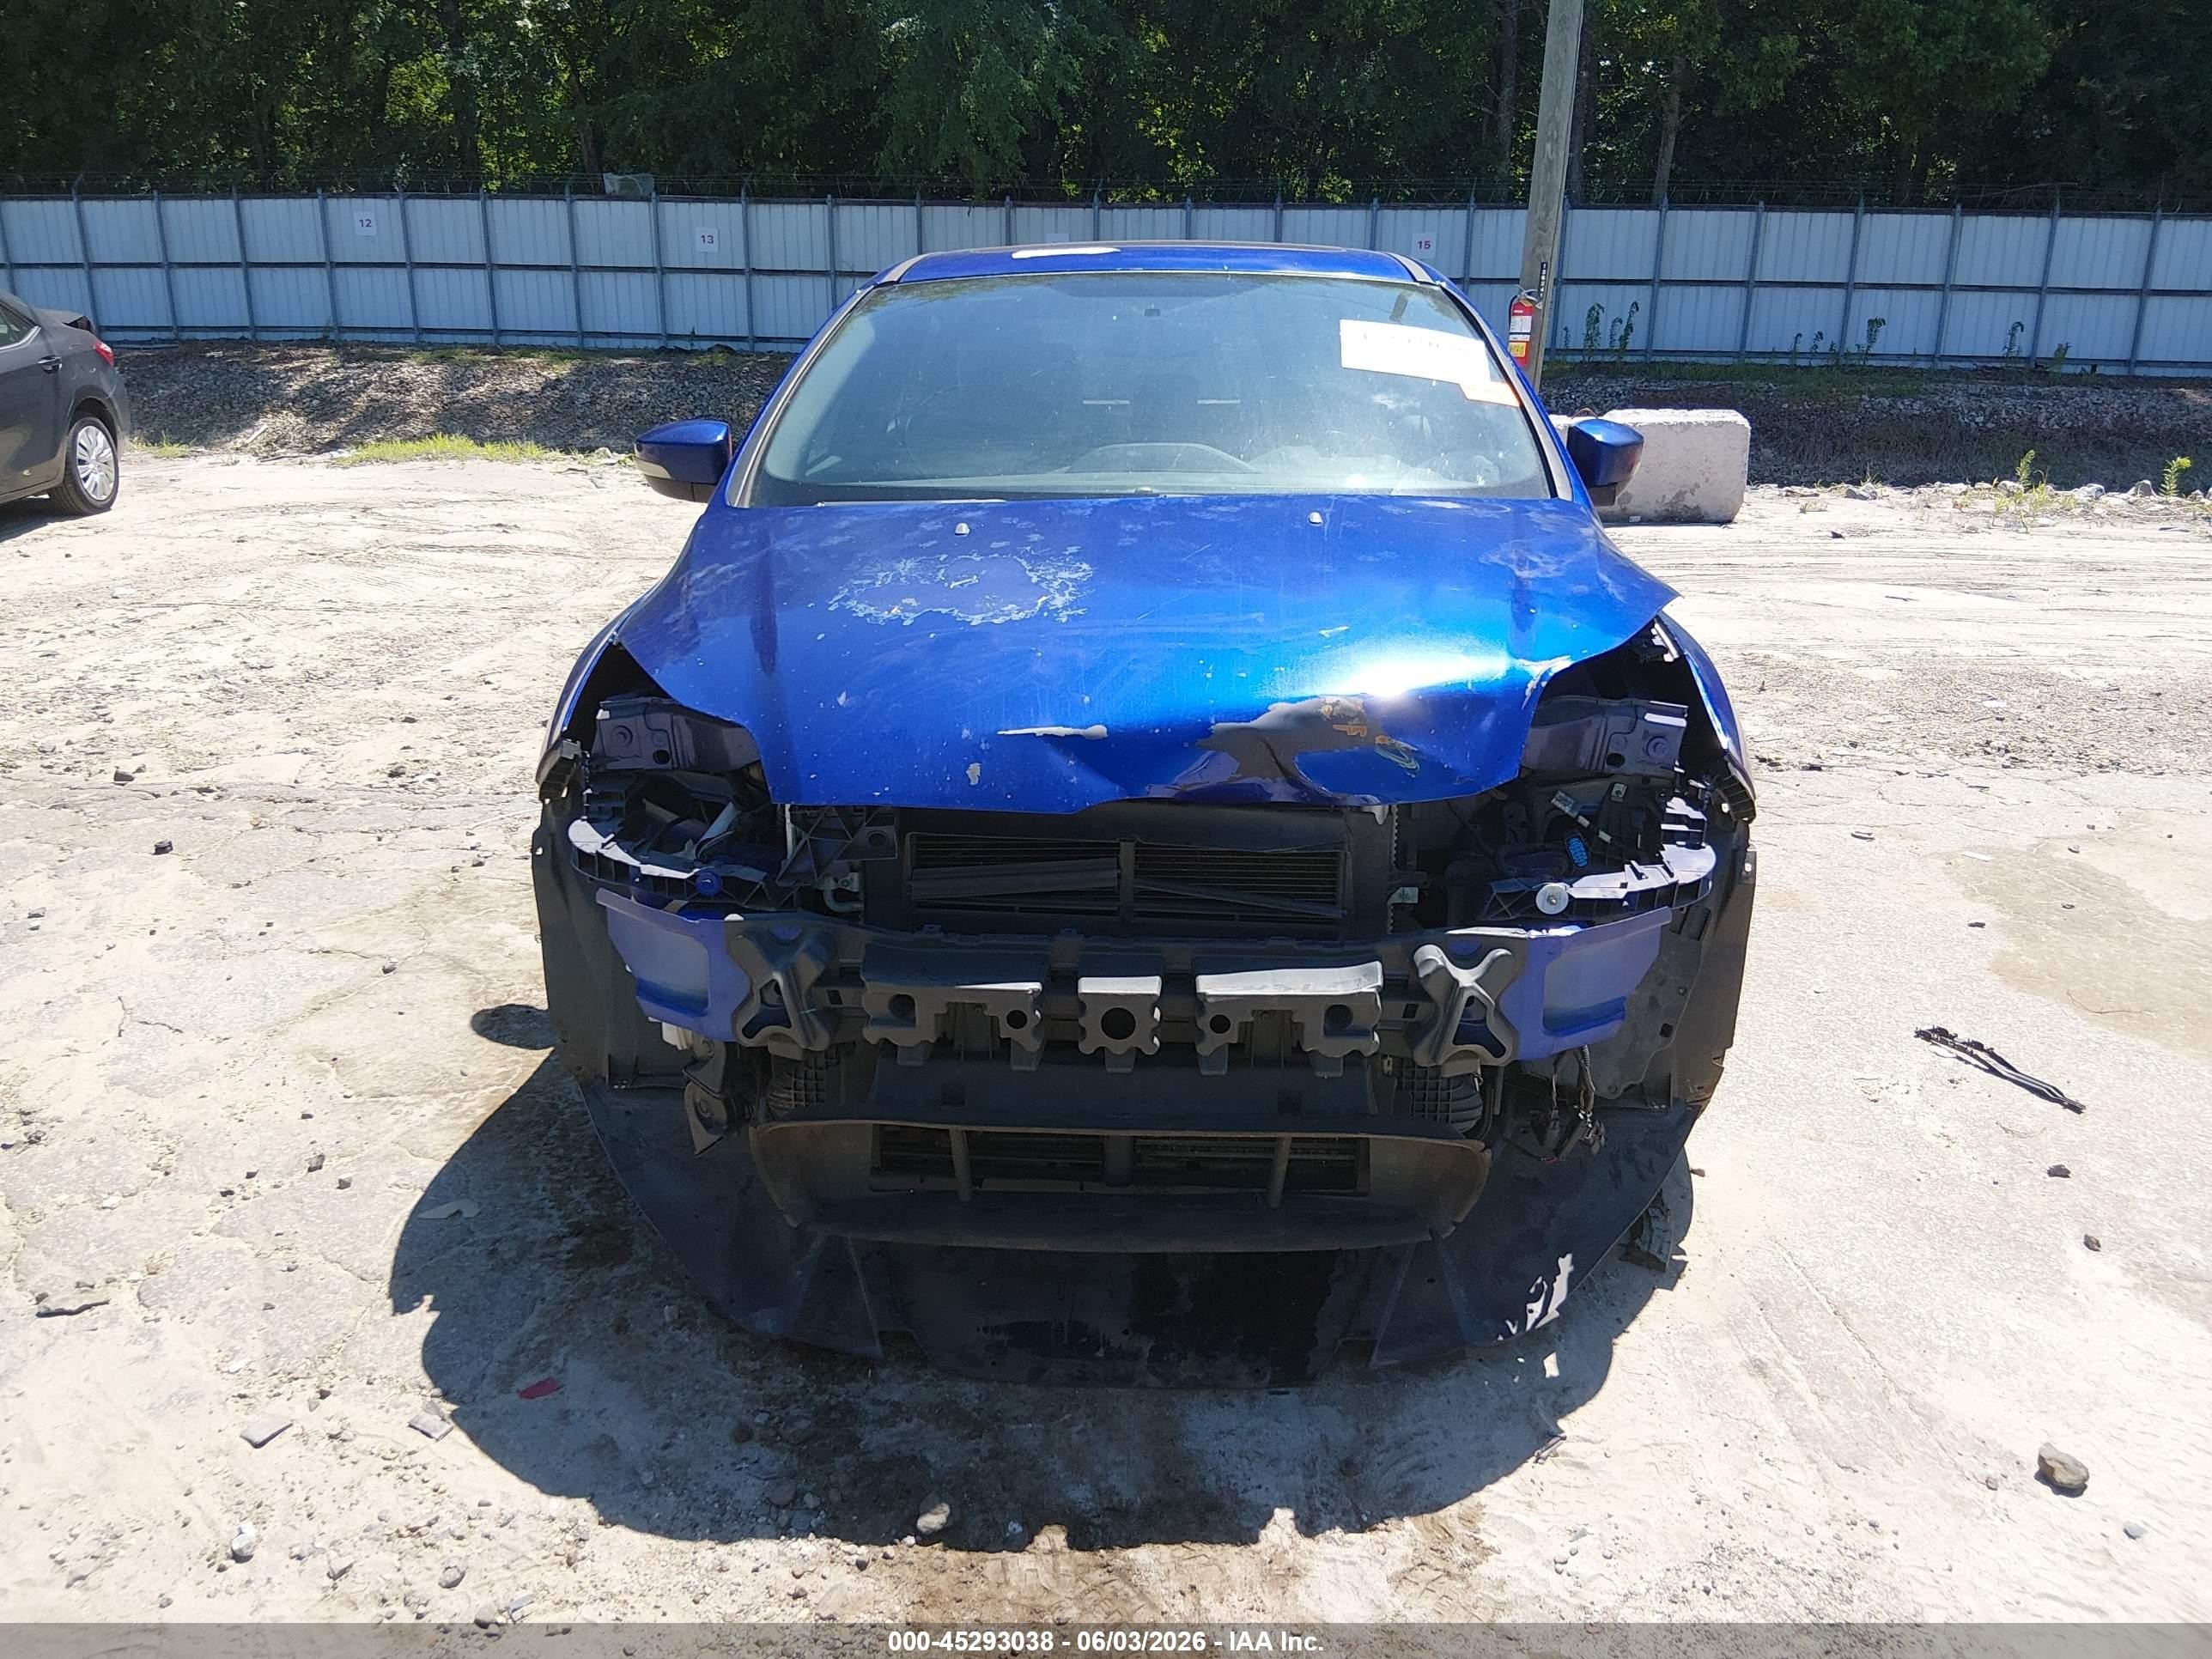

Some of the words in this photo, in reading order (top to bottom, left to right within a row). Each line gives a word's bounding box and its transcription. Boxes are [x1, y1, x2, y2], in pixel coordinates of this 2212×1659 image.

[359, 218, 372, 228] 12
[701, 234, 714, 244] 13
[1417, 240, 1431, 250] 15
